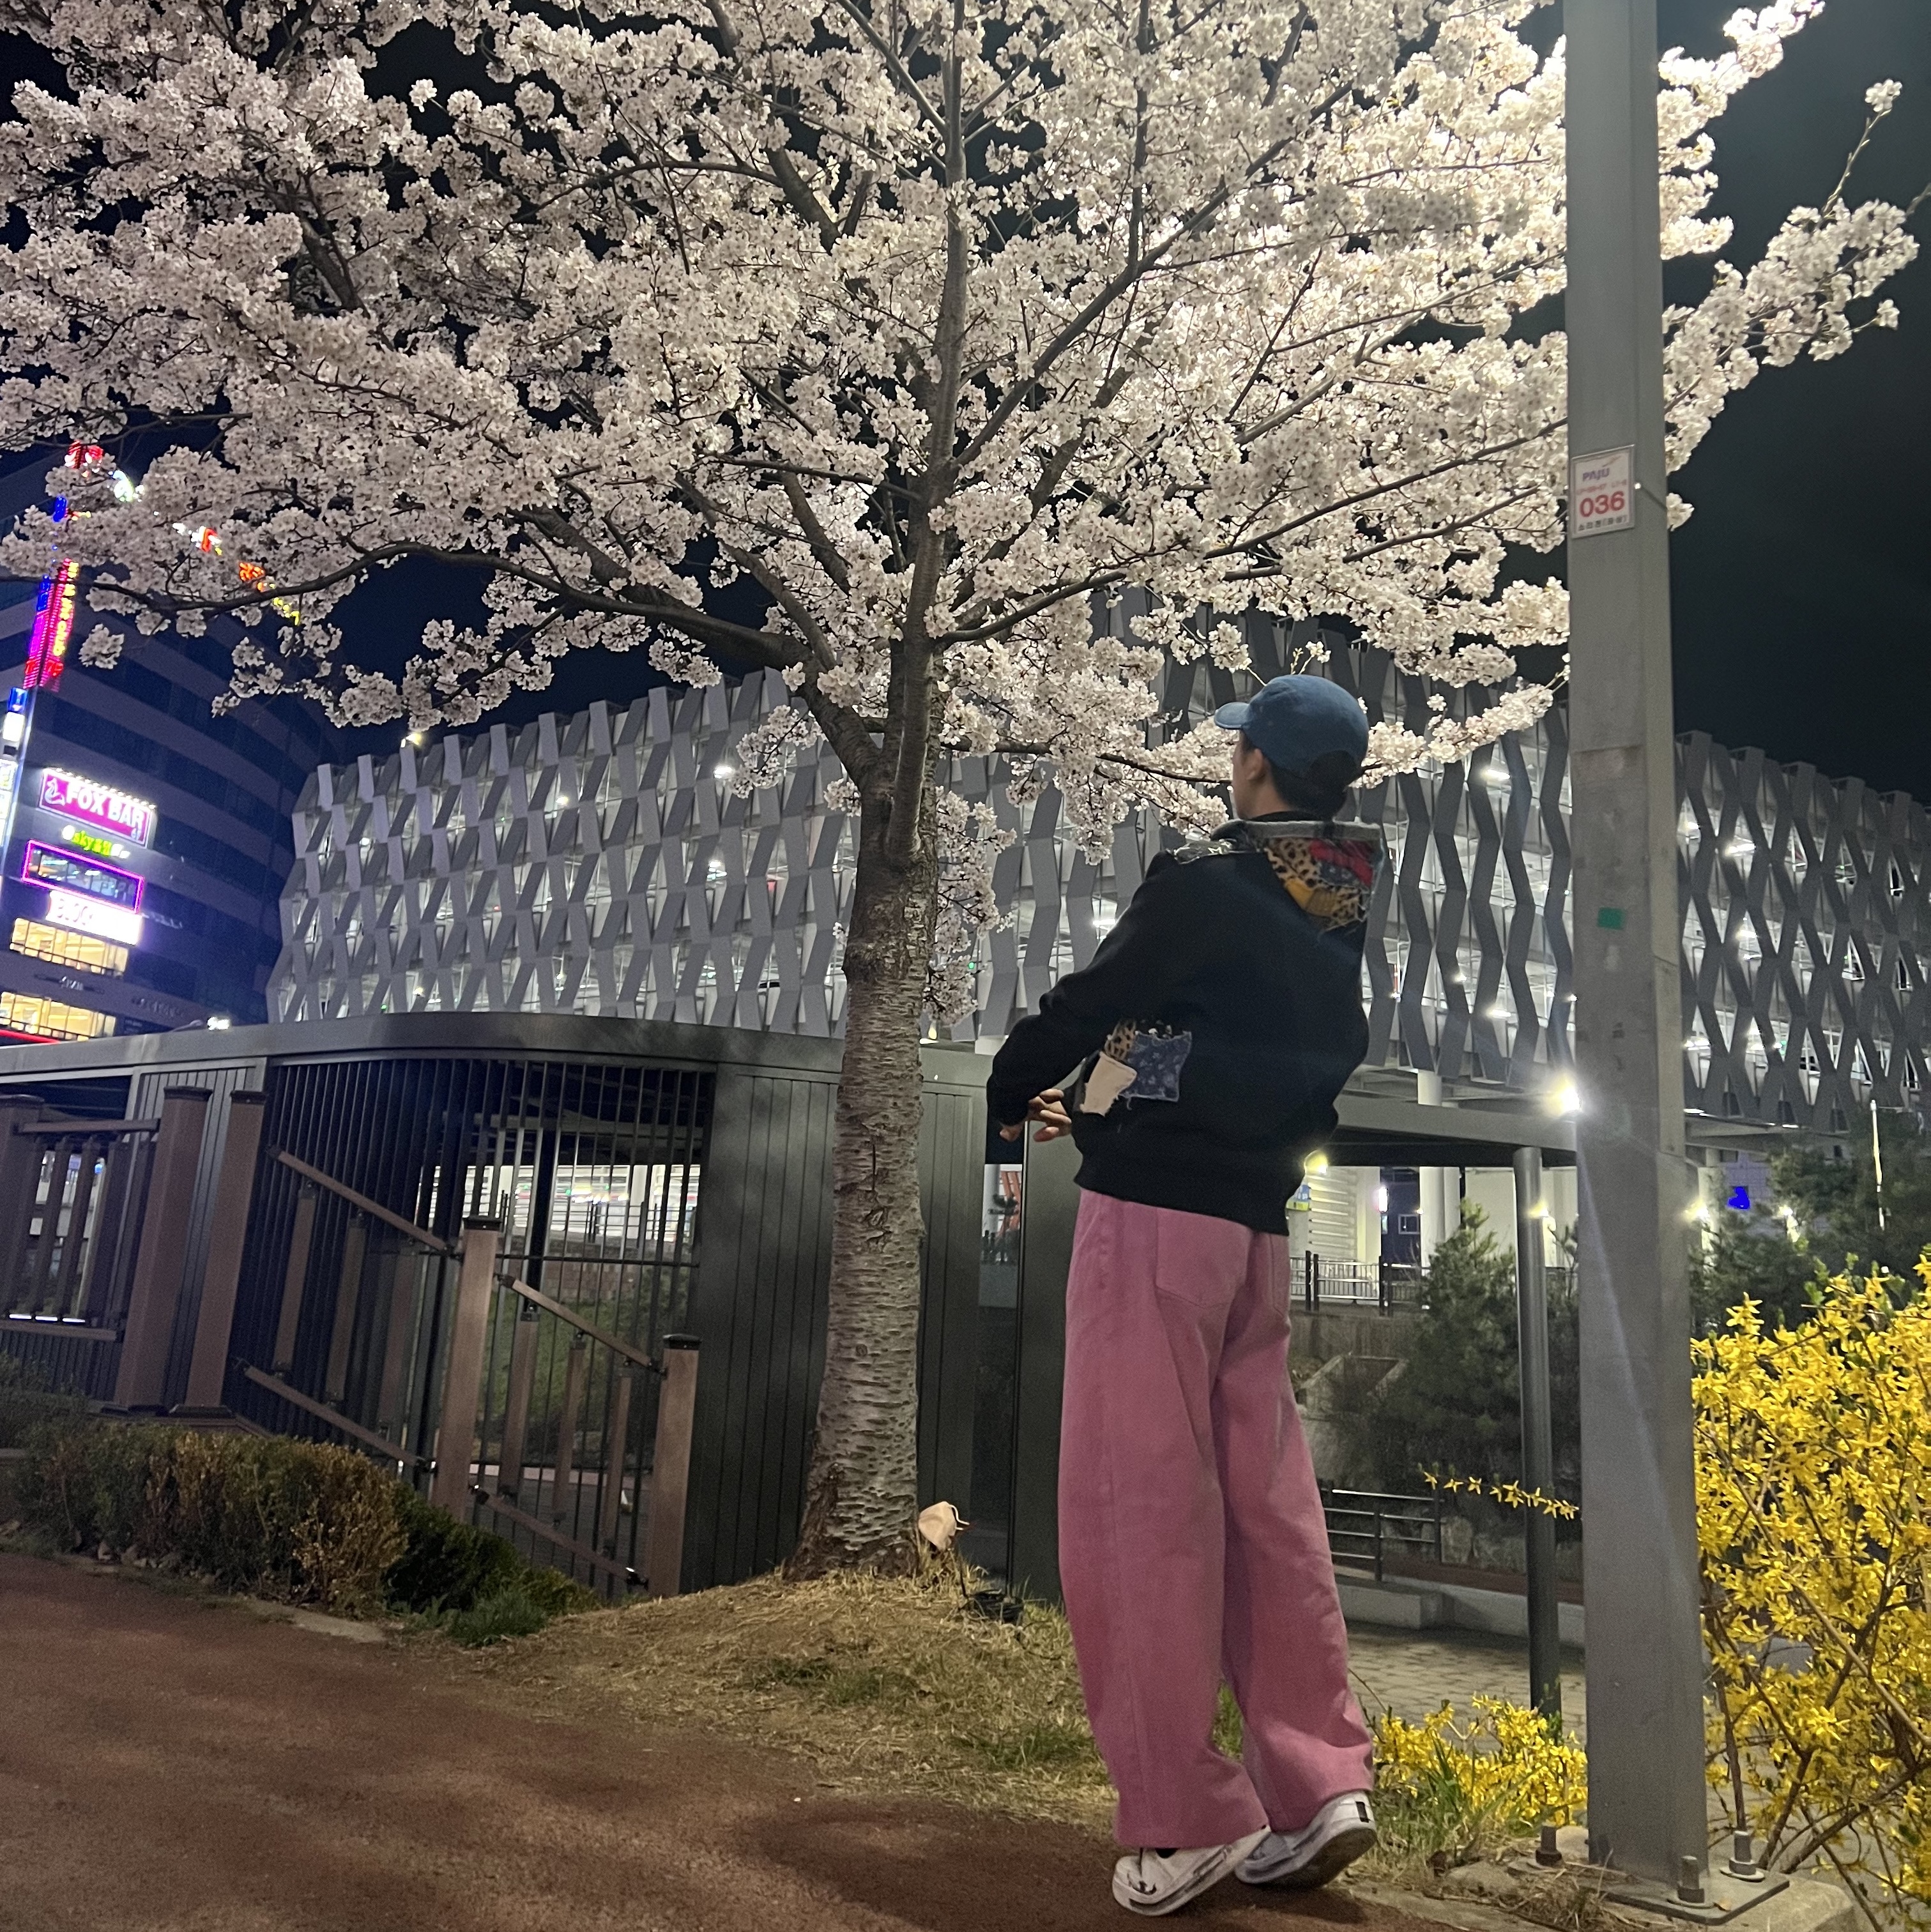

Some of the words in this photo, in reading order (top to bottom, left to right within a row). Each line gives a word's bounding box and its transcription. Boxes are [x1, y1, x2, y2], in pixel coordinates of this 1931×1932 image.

[1583, 468, 1609, 482] PAJU
[1580, 491, 1624, 517] 036
[66, 782, 107, 816] FOX
[107, 796, 145, 830] BAR
